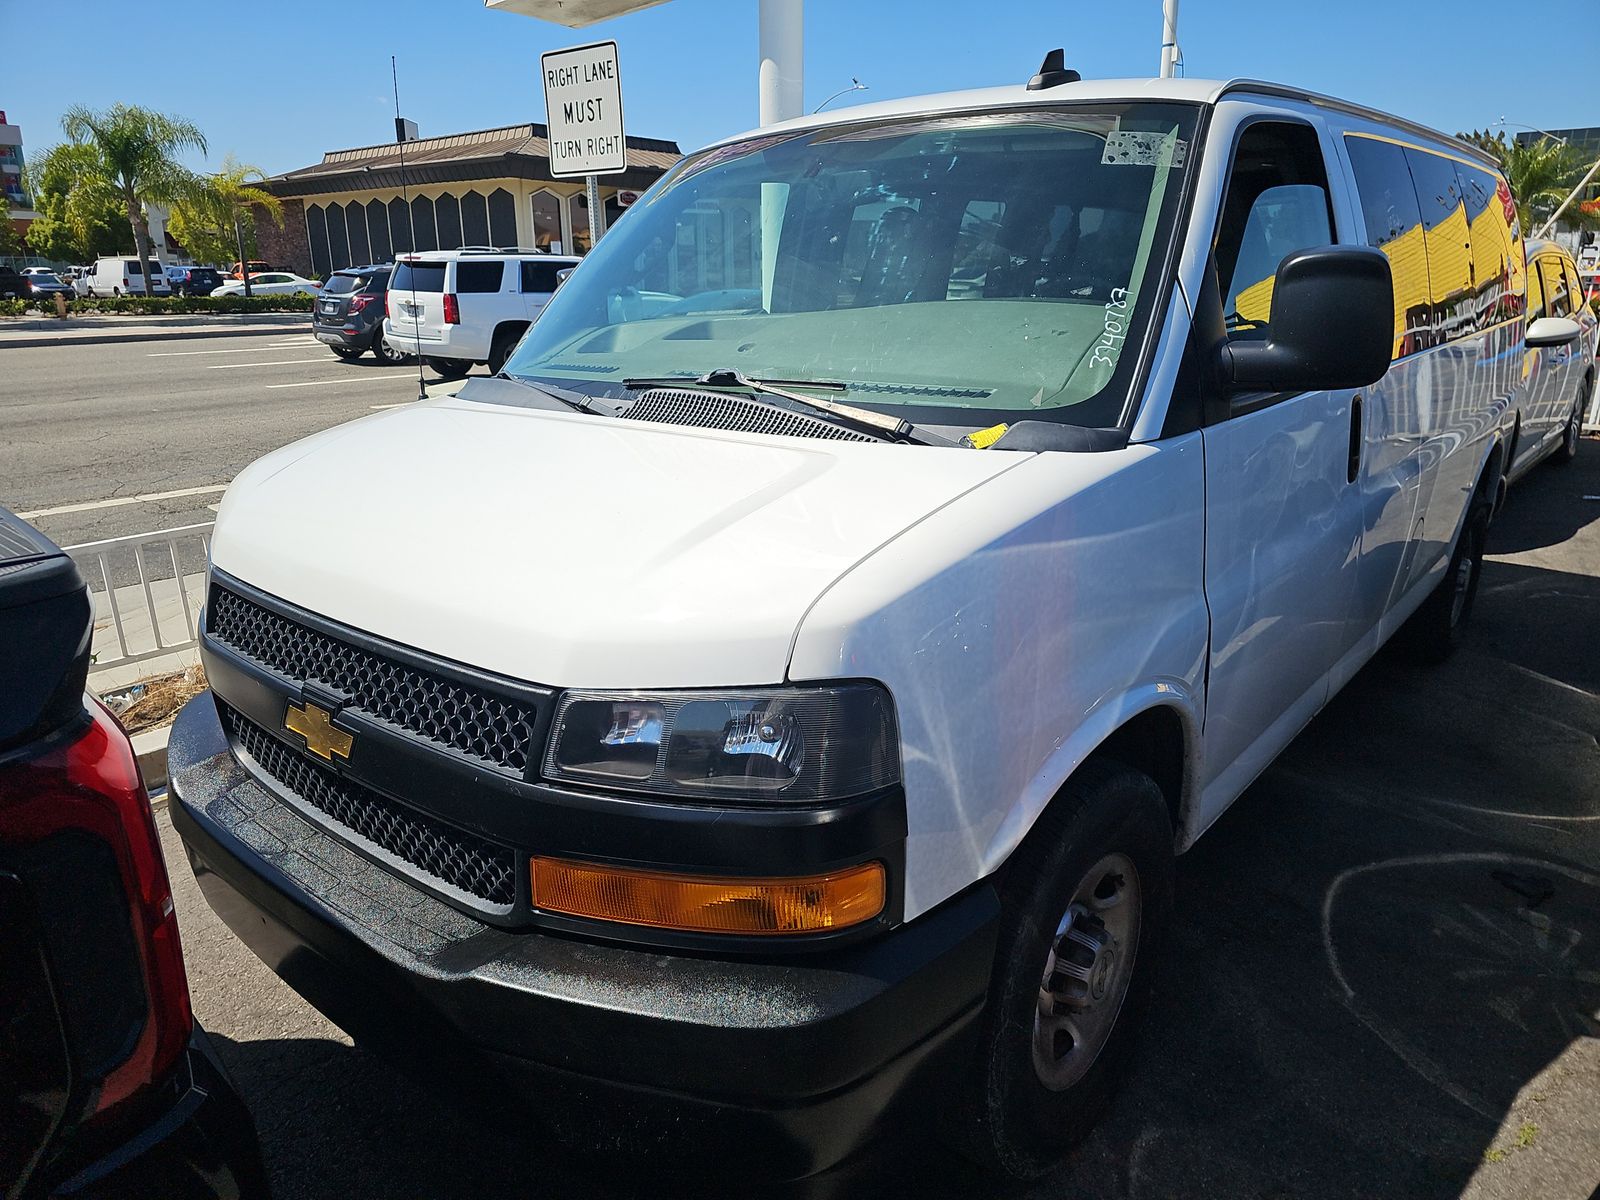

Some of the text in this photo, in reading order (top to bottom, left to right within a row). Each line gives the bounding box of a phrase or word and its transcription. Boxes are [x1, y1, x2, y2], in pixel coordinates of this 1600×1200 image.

[547, 60, 614, 88] RIGHT LANE
[563, 98, 603, 124] MUST
[553, 135, 619, 159] TURN RIGHT
